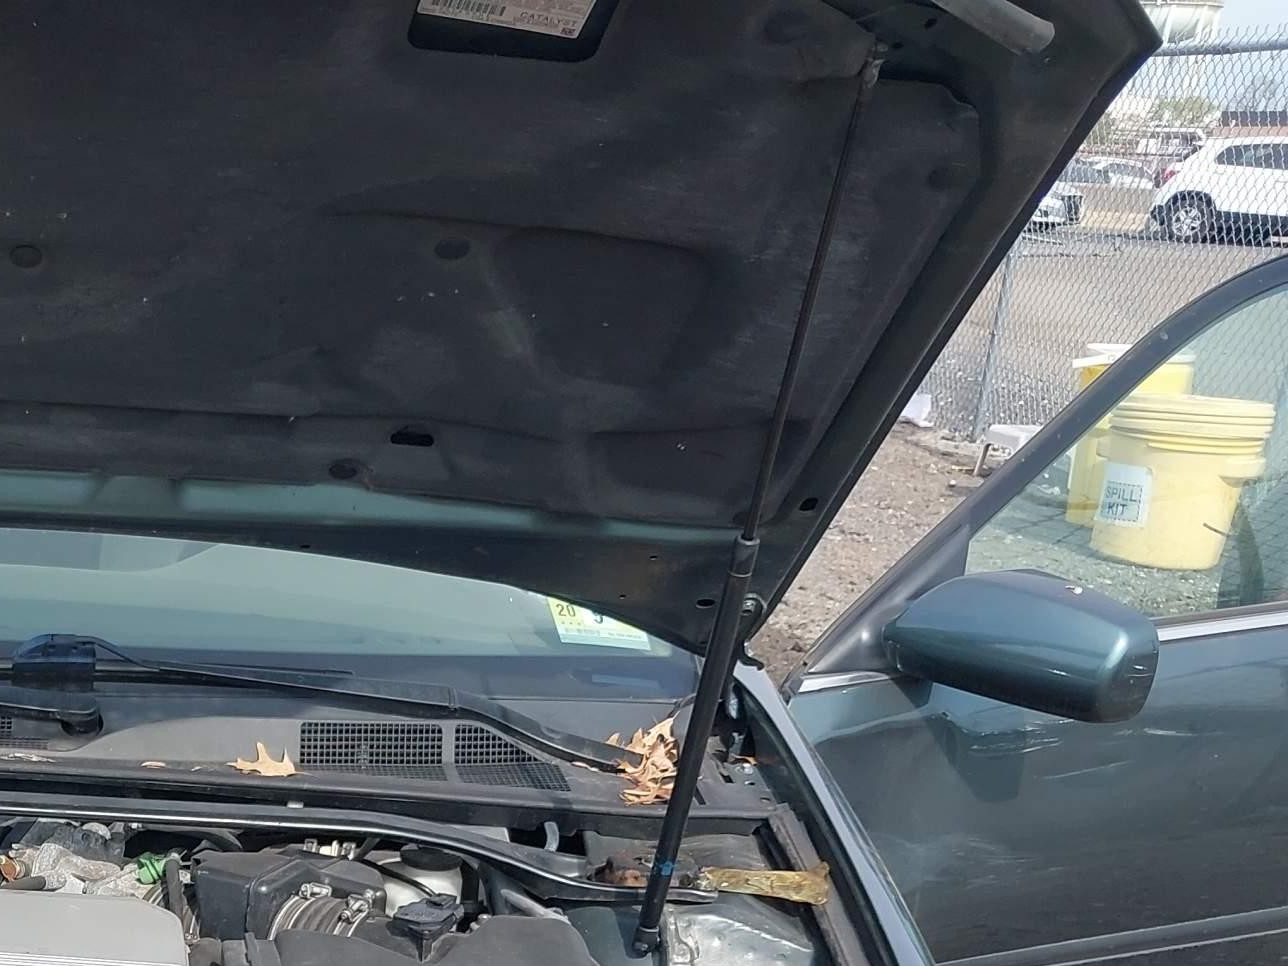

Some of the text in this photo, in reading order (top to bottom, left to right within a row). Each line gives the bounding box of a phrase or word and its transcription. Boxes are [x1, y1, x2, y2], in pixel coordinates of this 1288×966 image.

[1106, 486, 1137, 502] SPILL
[1107, 502, 1128, 515] KIT
[556, 603, 576, 617] 20
